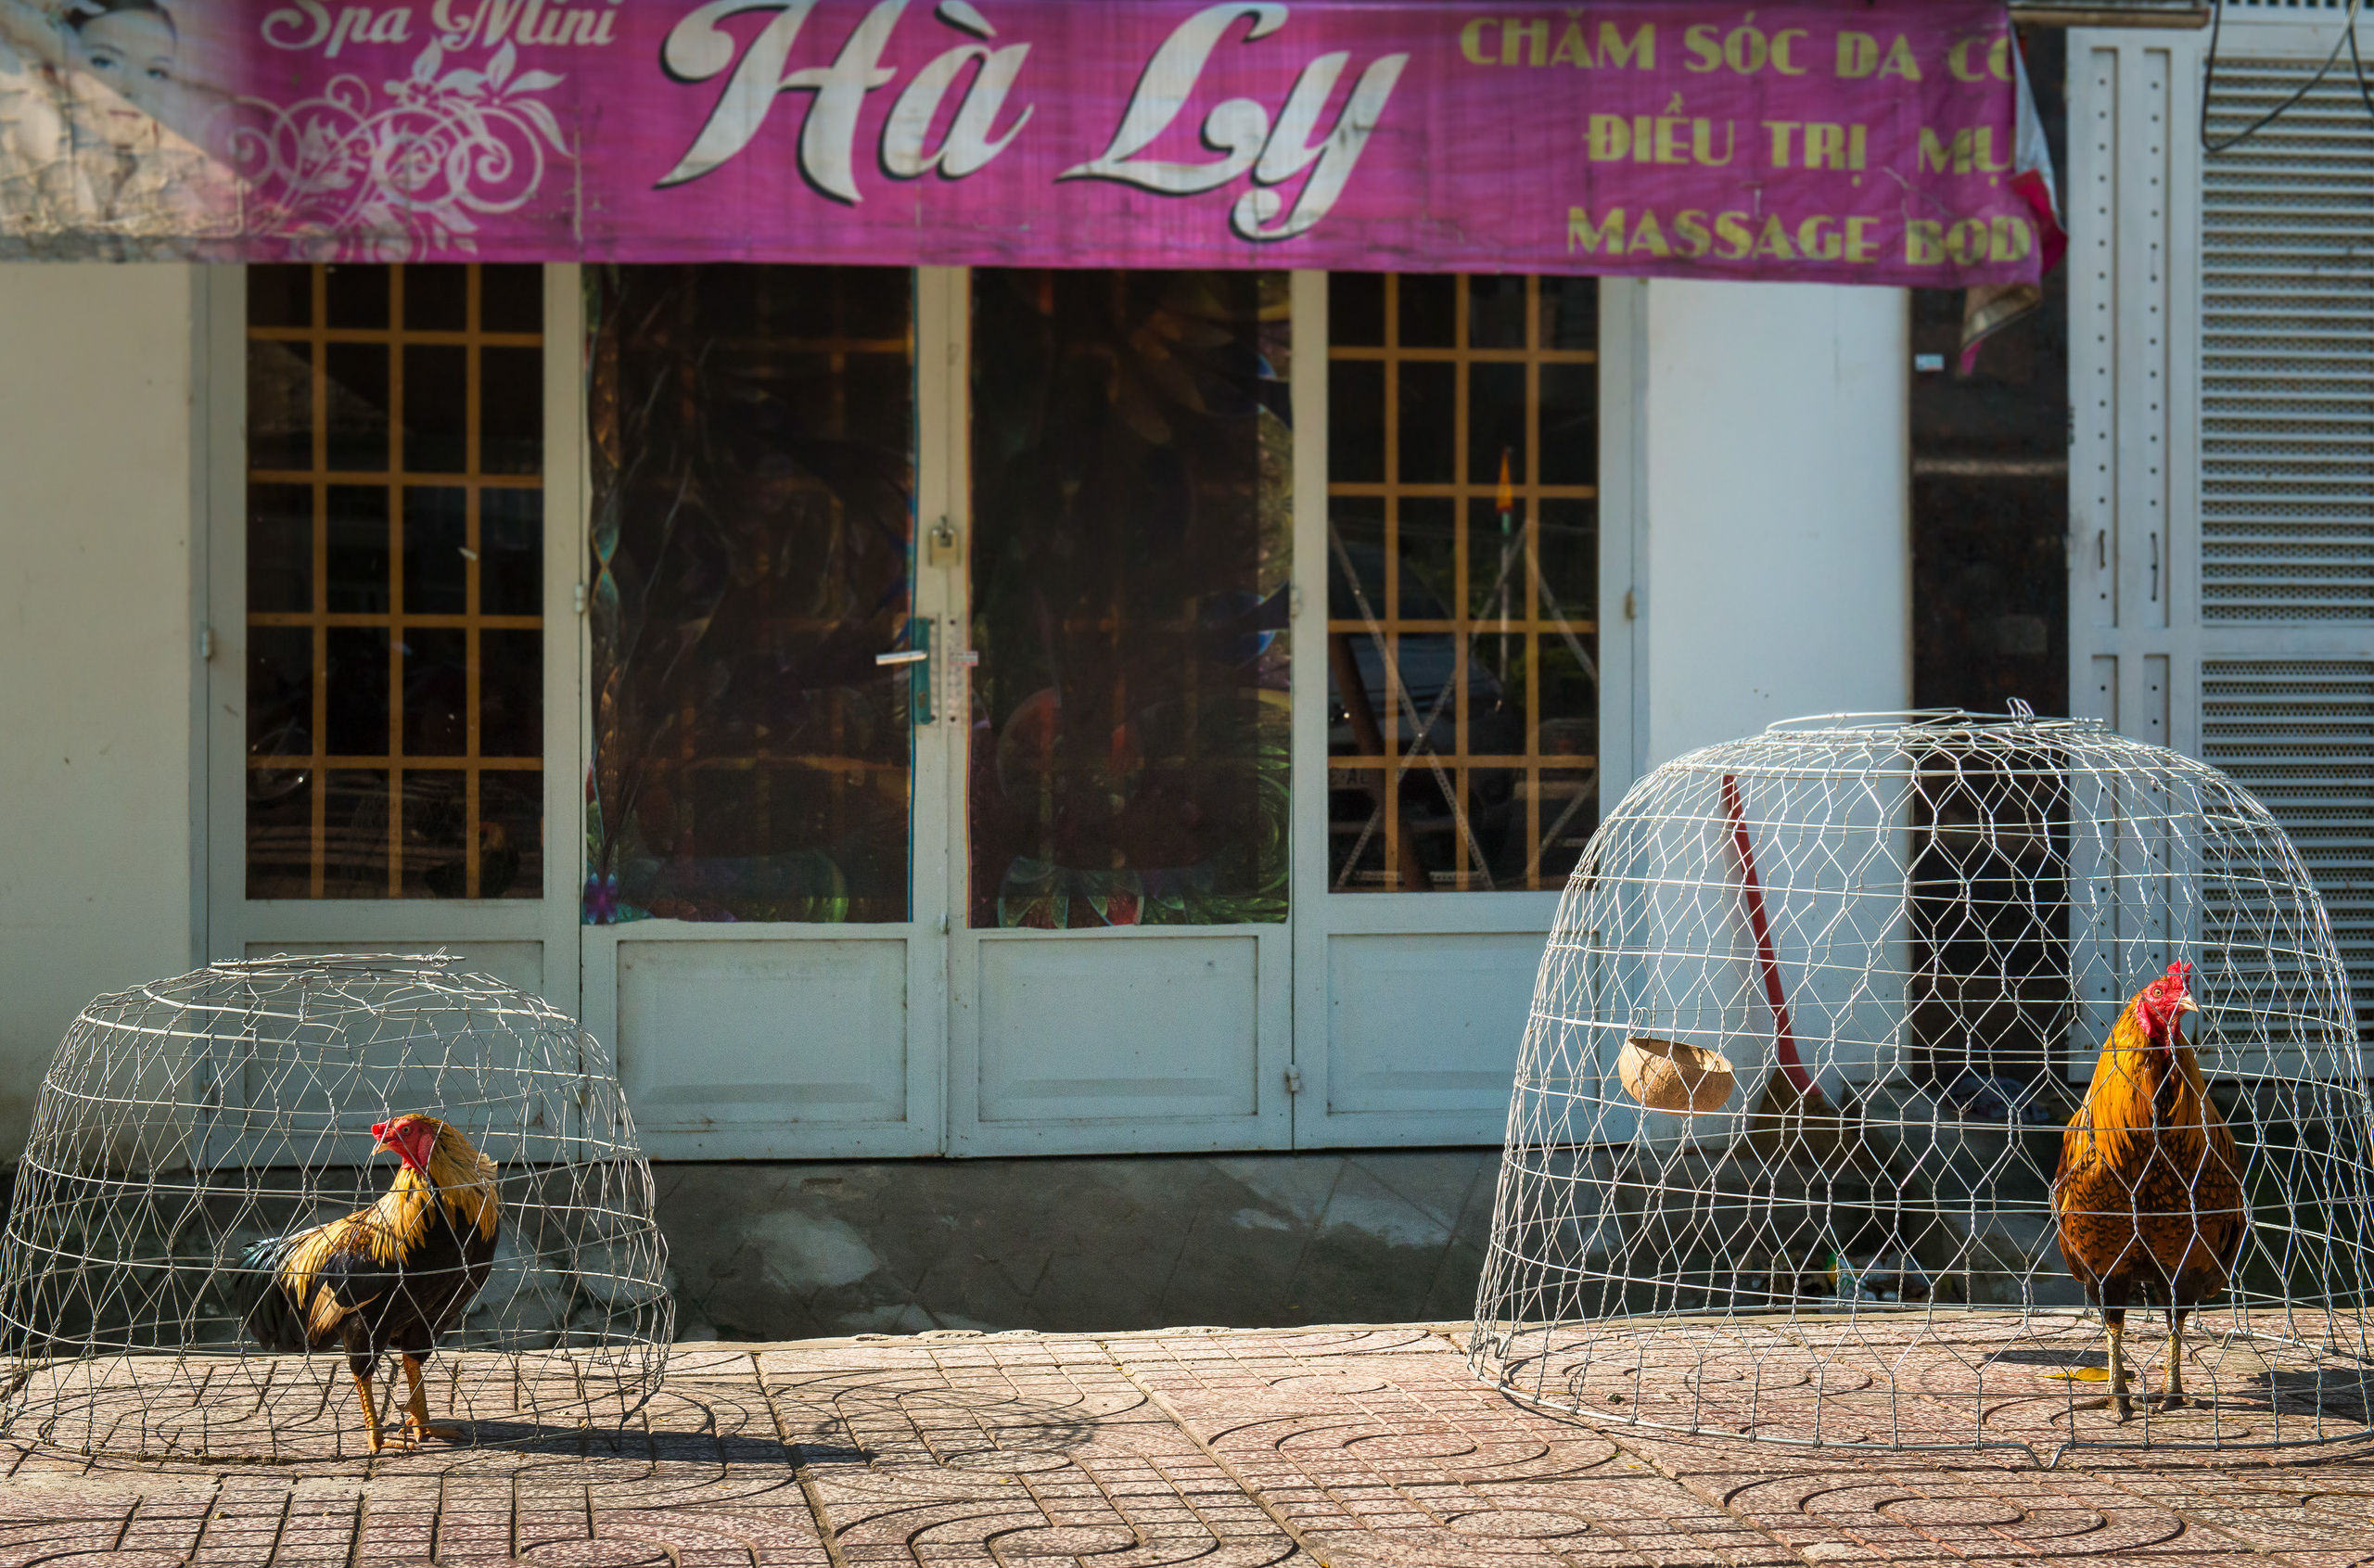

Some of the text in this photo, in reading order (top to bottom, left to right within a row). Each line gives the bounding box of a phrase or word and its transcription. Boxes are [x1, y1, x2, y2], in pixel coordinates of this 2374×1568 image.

[261, 0, 624, 58] Spa Mini
[1459, 6, 1656, 70] CHĂM
[1683, 11, 1807, 76] SÓC
[1835, 31, 1922, 81] DA
[652, 0, 1410, 243] Hà Ly
[1761, 121, 1867, 187] TRỊ
[1567, 207, 1880, 263] MASSAGE
